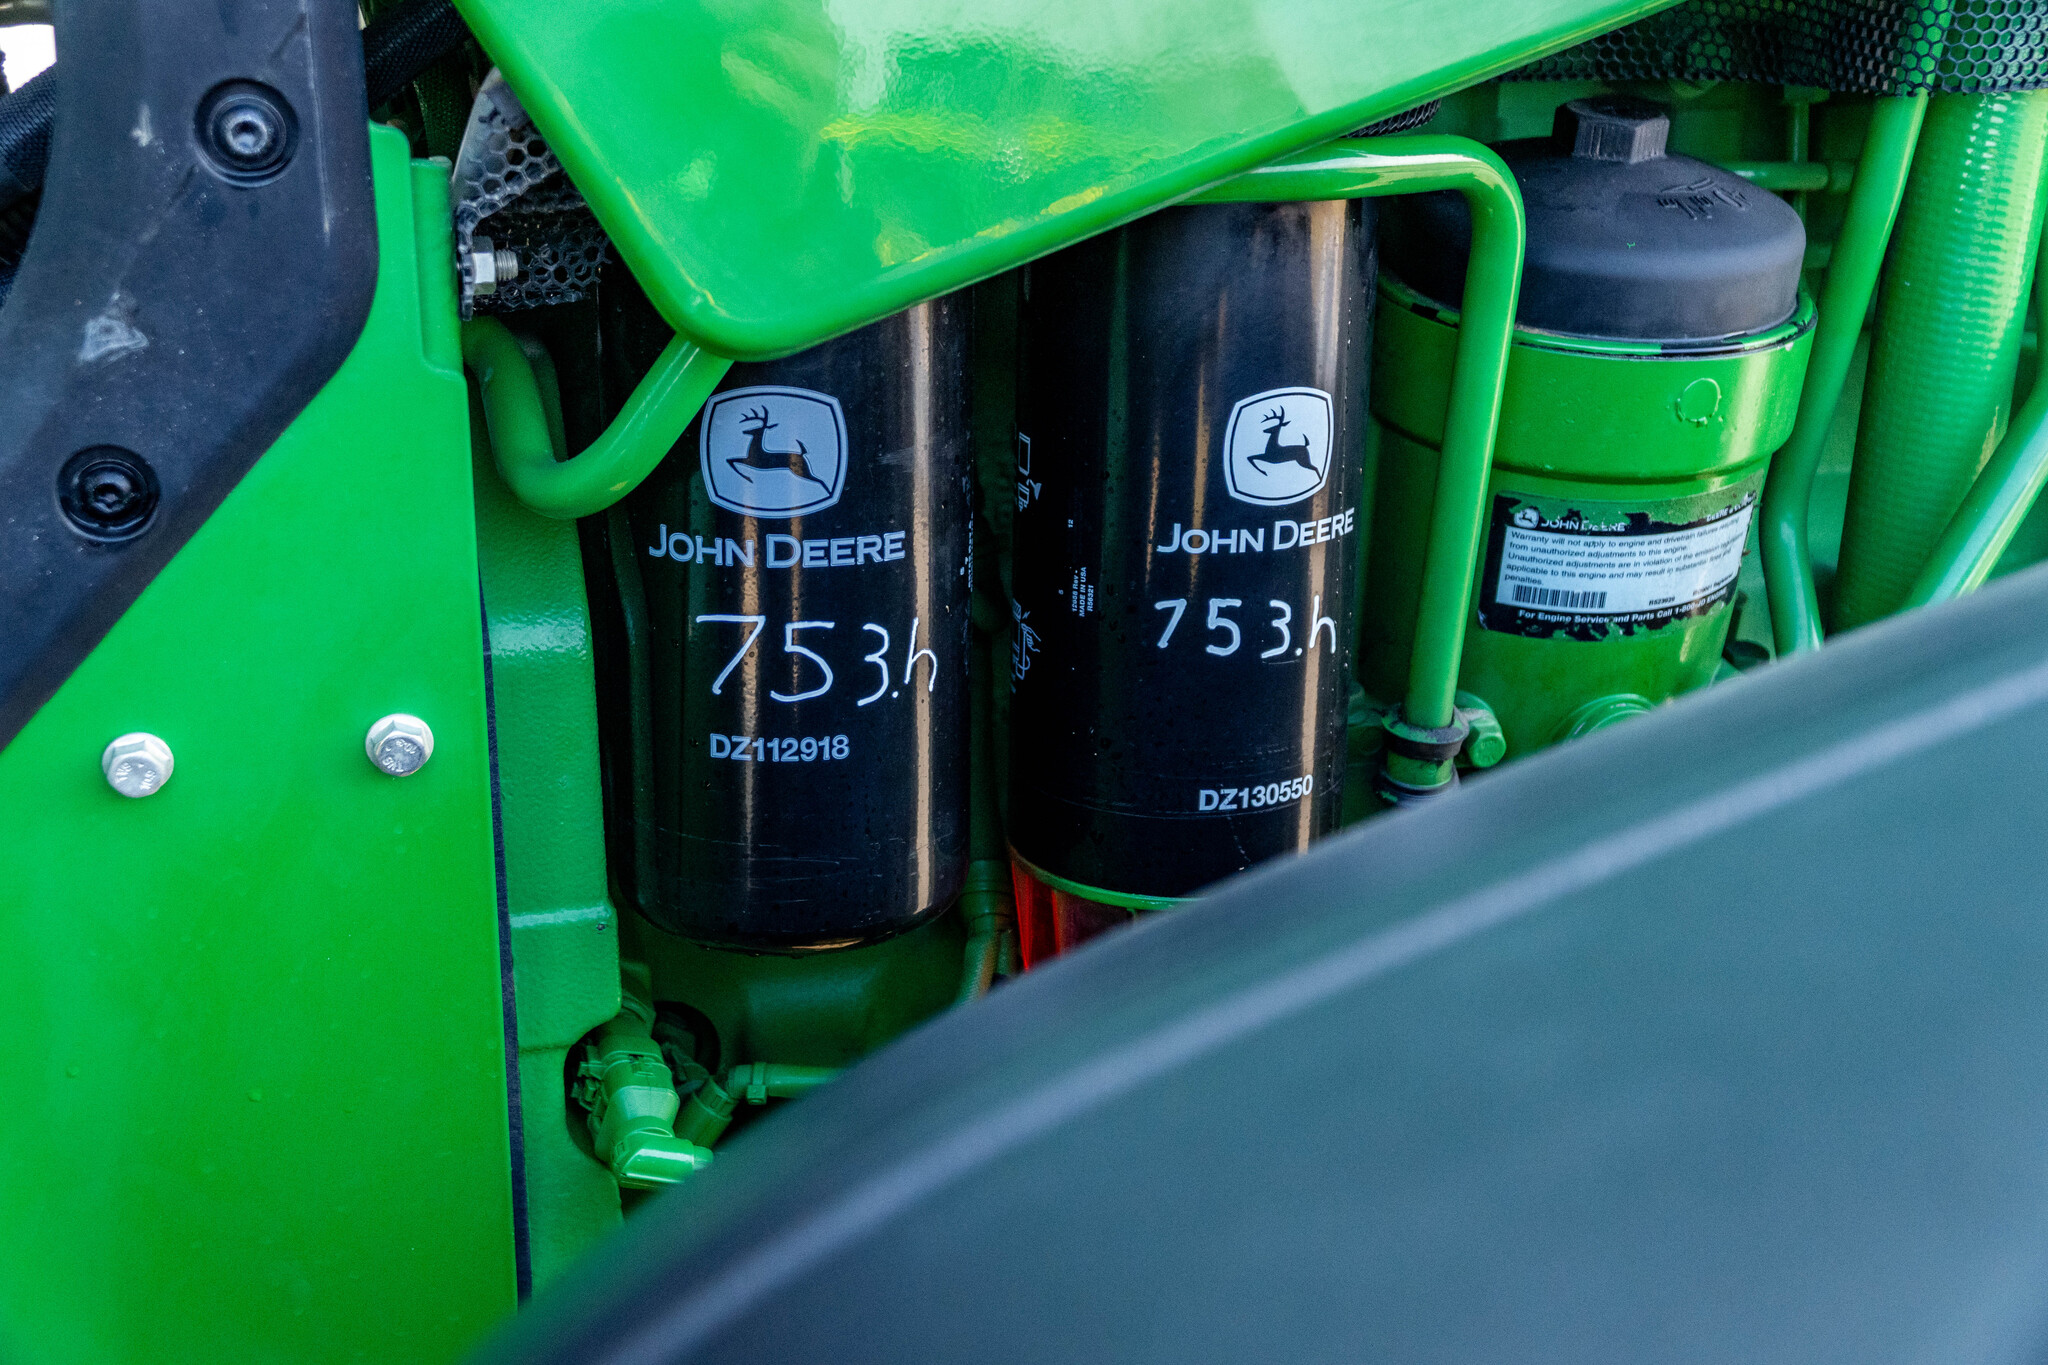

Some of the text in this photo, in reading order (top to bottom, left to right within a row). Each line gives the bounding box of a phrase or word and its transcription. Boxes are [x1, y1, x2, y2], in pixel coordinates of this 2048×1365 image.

[1067, 519, 1074, 528] 12
[1157, 507, 1355, 554] JOHN DEERE
[649, 524, 906, 568] JOHN DEERE
[1511, 531, 1549, 544] Warranty
[1583, 540, 1606, 549] apply
[1618, 539, 1645, 549] engine
[1647, 537, 1662, 546] and
[1664, 532, 1695, 544] drivetrain
[1509, 541, 1528, 551] from
[1530, 545, 1585, 557] unauthorized
[1587, 550, 1636, 559] adjustments
[1638, 549, 1646, 557] to
[1648, 548, 1661, 556] this
[1508, 551, 1564, 567] Unauthorized
[1565, 560, 1616, 569] adjustments
[1617, 560, 1631, 568] are
[1643, 557, 1673, 567] violation
[1504, 573, 1544, 586] penalties.
[1506, 563, 1549, 575] applicable
[1561, 570, 1576, 578] this
[1578, 572, 1607, 580] engine
[1626, 571, 1643, 580] may
[1645, 568, 1666, 577] result
[1080, 583, 1086, 594] IN
[1519, 609, 1536, 619] For
[1538, 611, 1572, 623] Engine
[1574, 614, 1609, 624] Service
[1612, 614, 1630, 623] and
[1631, 612, 1655, 622] Parts
[1656, 608, 1673, 619] Call
[710, 733, 850, 762] DZ112918
[1199, 775, 1314, 811] DZ130550
